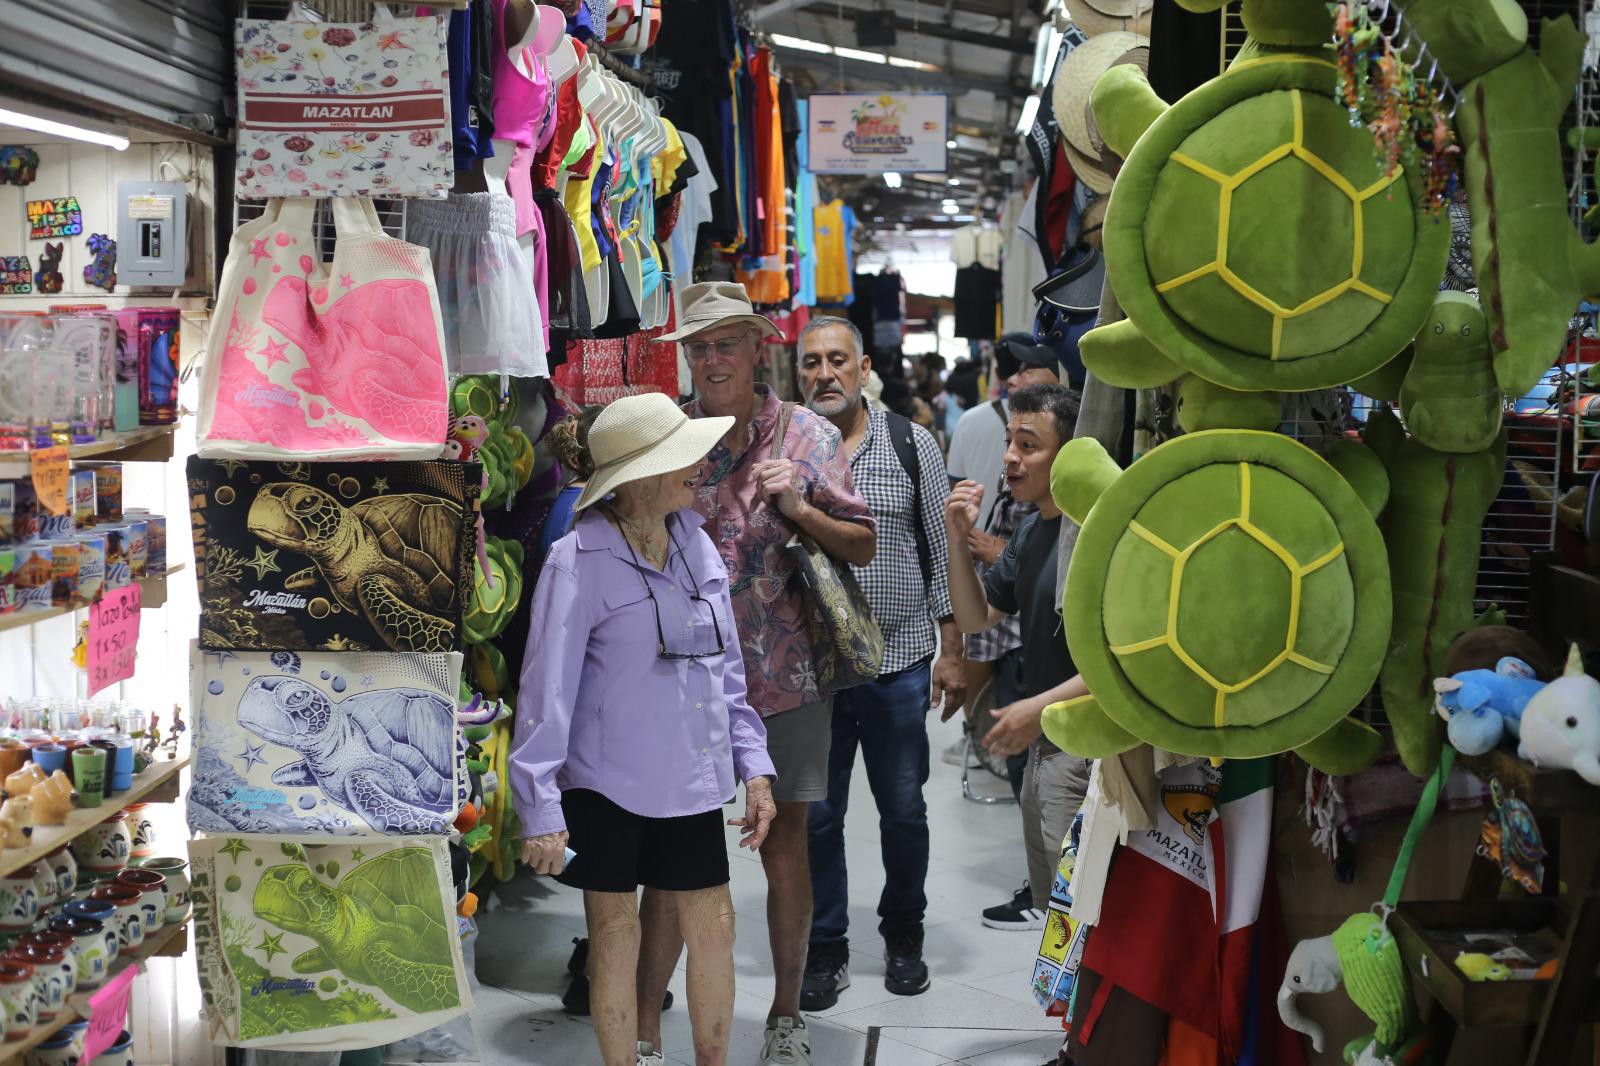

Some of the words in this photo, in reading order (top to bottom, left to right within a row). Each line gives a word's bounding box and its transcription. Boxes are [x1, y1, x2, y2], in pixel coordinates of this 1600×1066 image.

[303, 106, 393, 118] MAZATLAN
[27, 198, 80, 214] MAZA
[243, 590, 307, 608] Mazatlán
[1147, 829, 1206, 870] MAZATL
[1163, 851, 1205, 879] MEXICO
